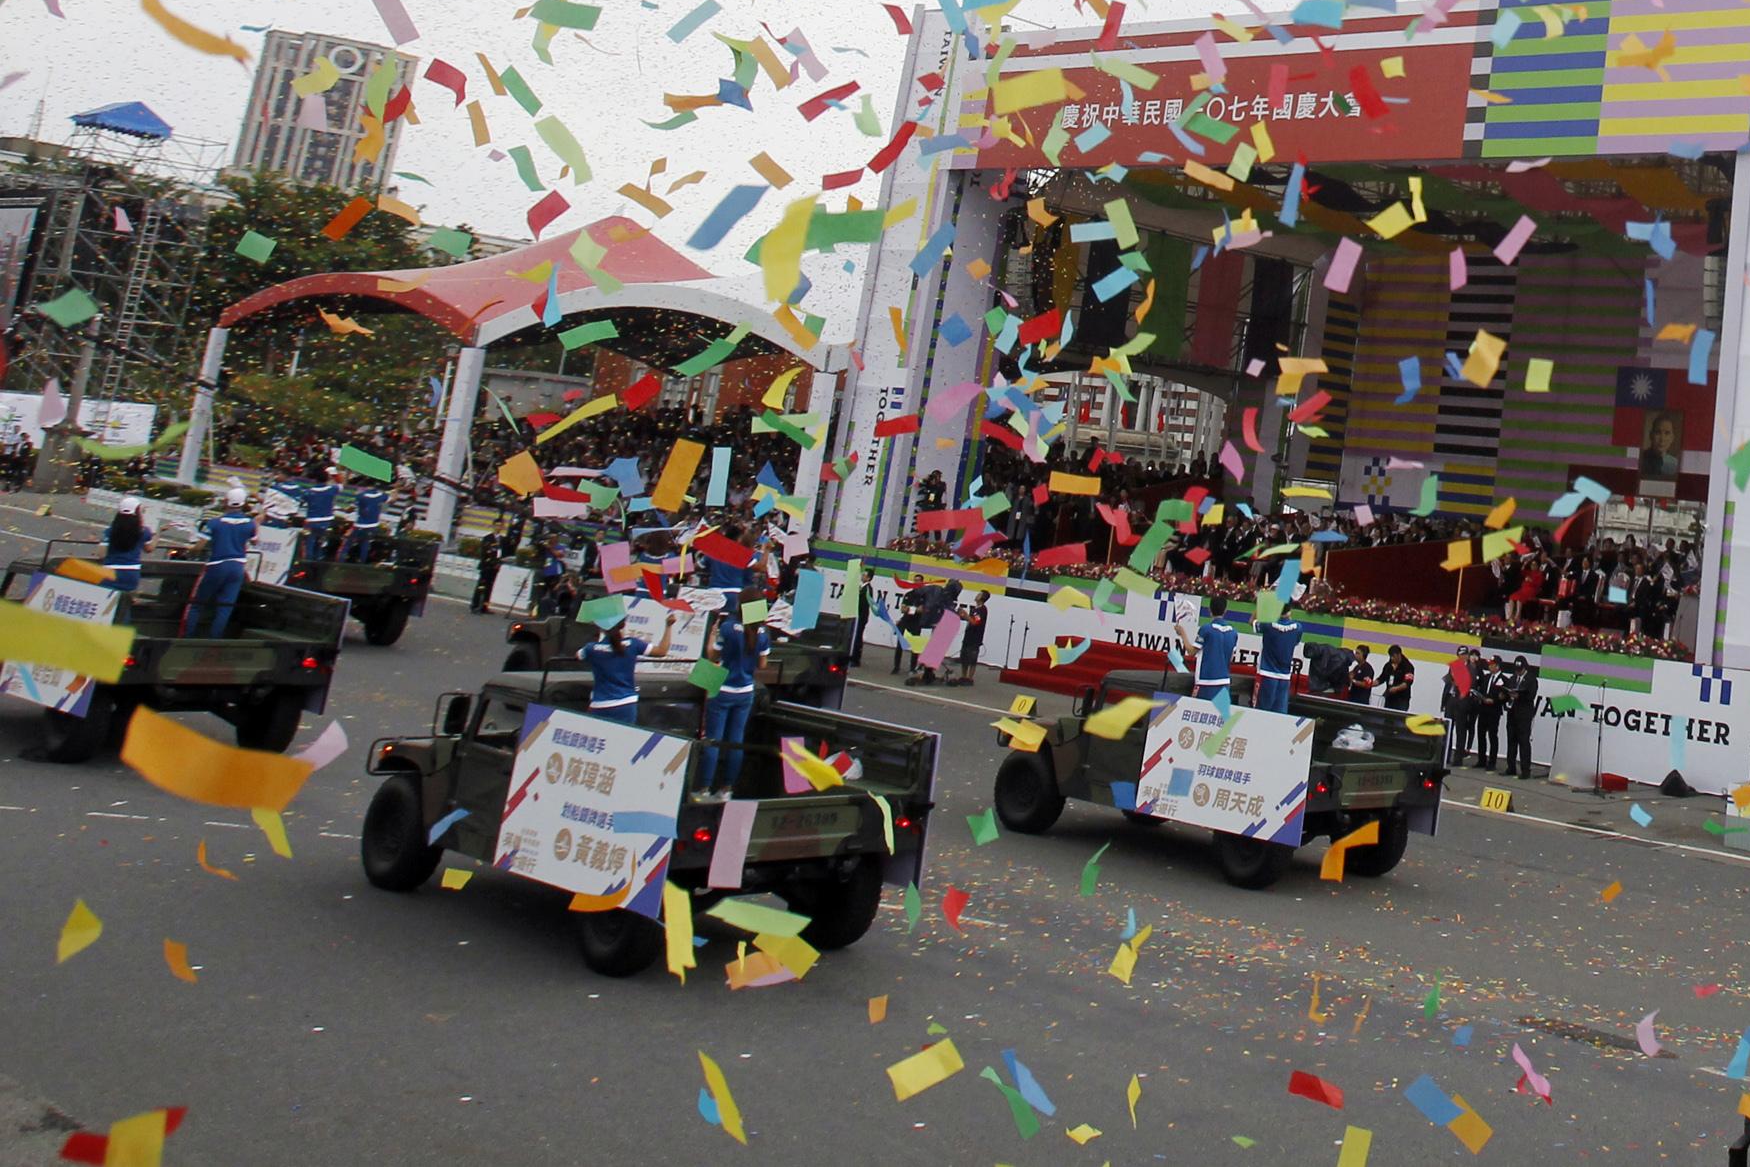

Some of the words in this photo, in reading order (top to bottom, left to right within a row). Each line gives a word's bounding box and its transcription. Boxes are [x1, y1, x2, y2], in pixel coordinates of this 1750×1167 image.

[863, 386, 888, 487] TOGTHER
[1589, 703, 1731, 747] TOGETHER
[1212, 787, 1265, 817] 周天成
[1485, 791, 1504, 810] 10
